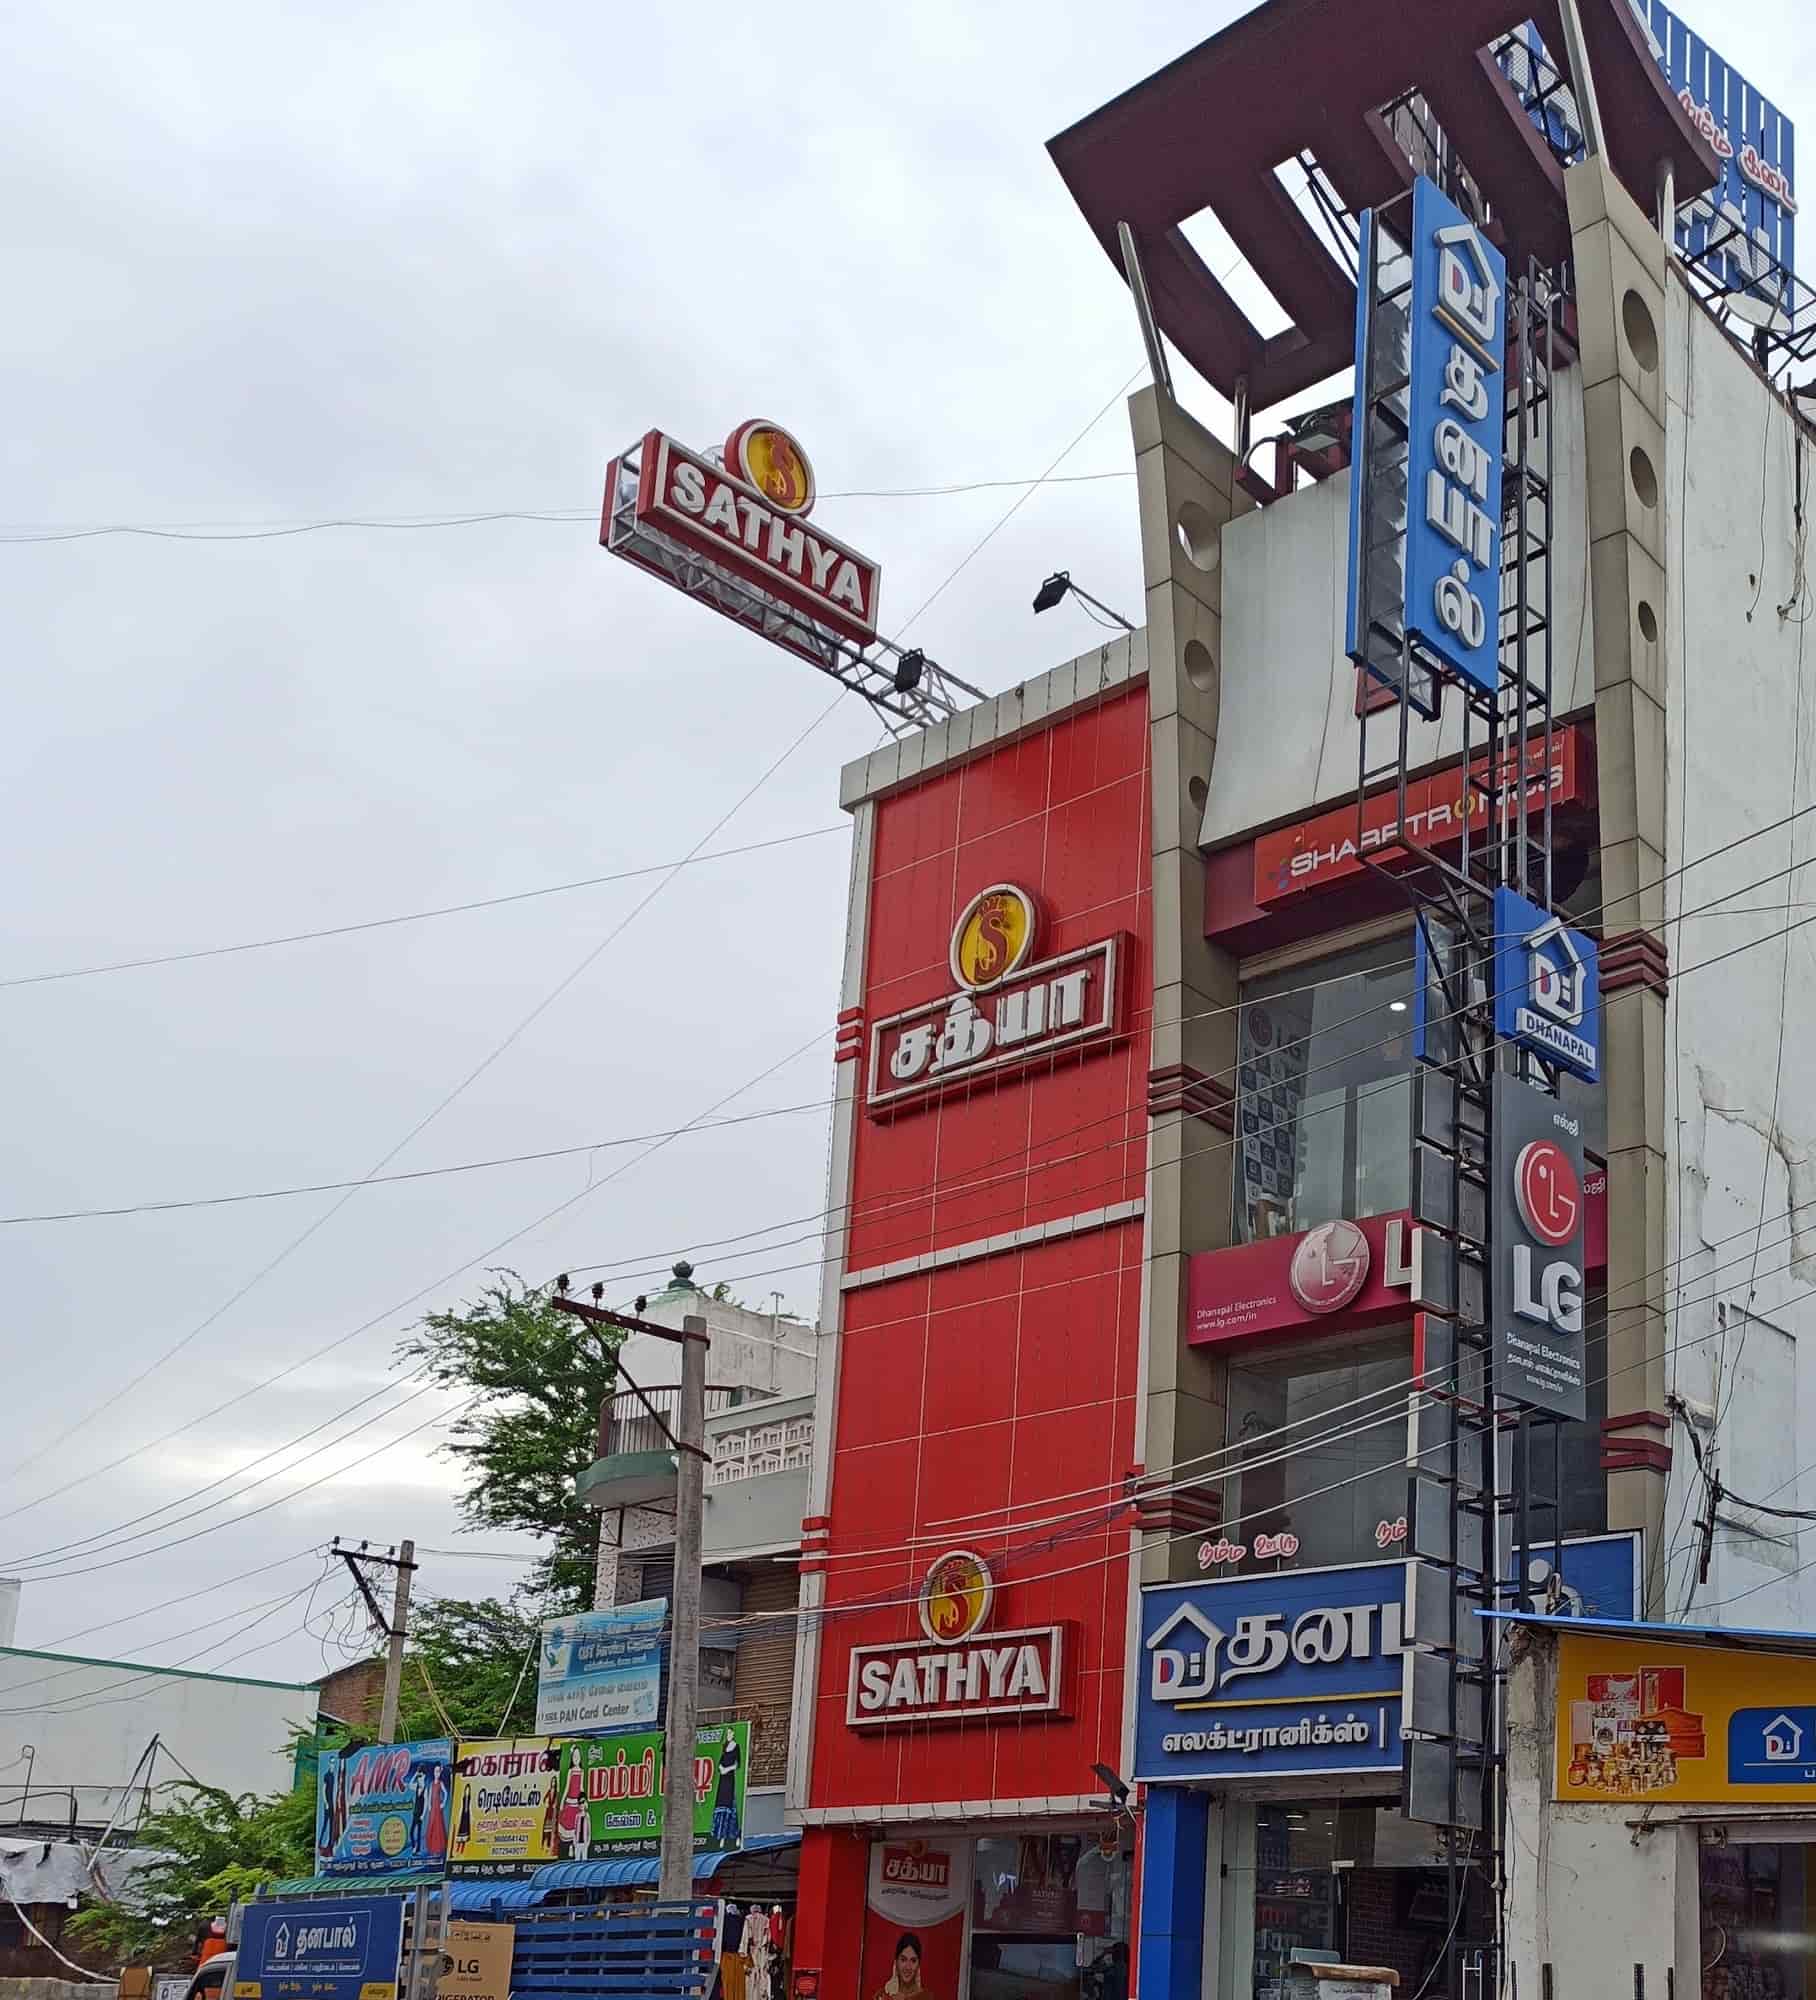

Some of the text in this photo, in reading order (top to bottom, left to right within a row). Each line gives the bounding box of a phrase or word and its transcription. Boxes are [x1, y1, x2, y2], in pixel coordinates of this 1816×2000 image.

[1426, 343, 1497, 650] தனபால்
[671, 462, 864, 613] SATHYA
[890, 969, 1091, 1078] சத்யா
[1526, 1013, 1593, 1063] DHANAPAL
[1235, 1295, 1278, 1312] Electronics
[1514, 1244, 1582, 1334] LG
[1198, 1538, 1247, 1569] நம்ம
[860, 1645, 1047, 1709] SATHYA
[560, 1707, 578, 1723] PAN
[580, 1703, 599, 1721] Card
[602, 1703, 630, 1718] Center
[1162, 1714, 1369, 1753] எலக்ட்ரானிக்ஸ்
[350, 1748, 412, 1798] AMR
[588, 1747, 655, 1801] மம்மி
[886, 1855, 946, 1883] சத்யா
[295, 1916, 357, 1960] தனபால்
[457, 1959, 480, 1974] LG
